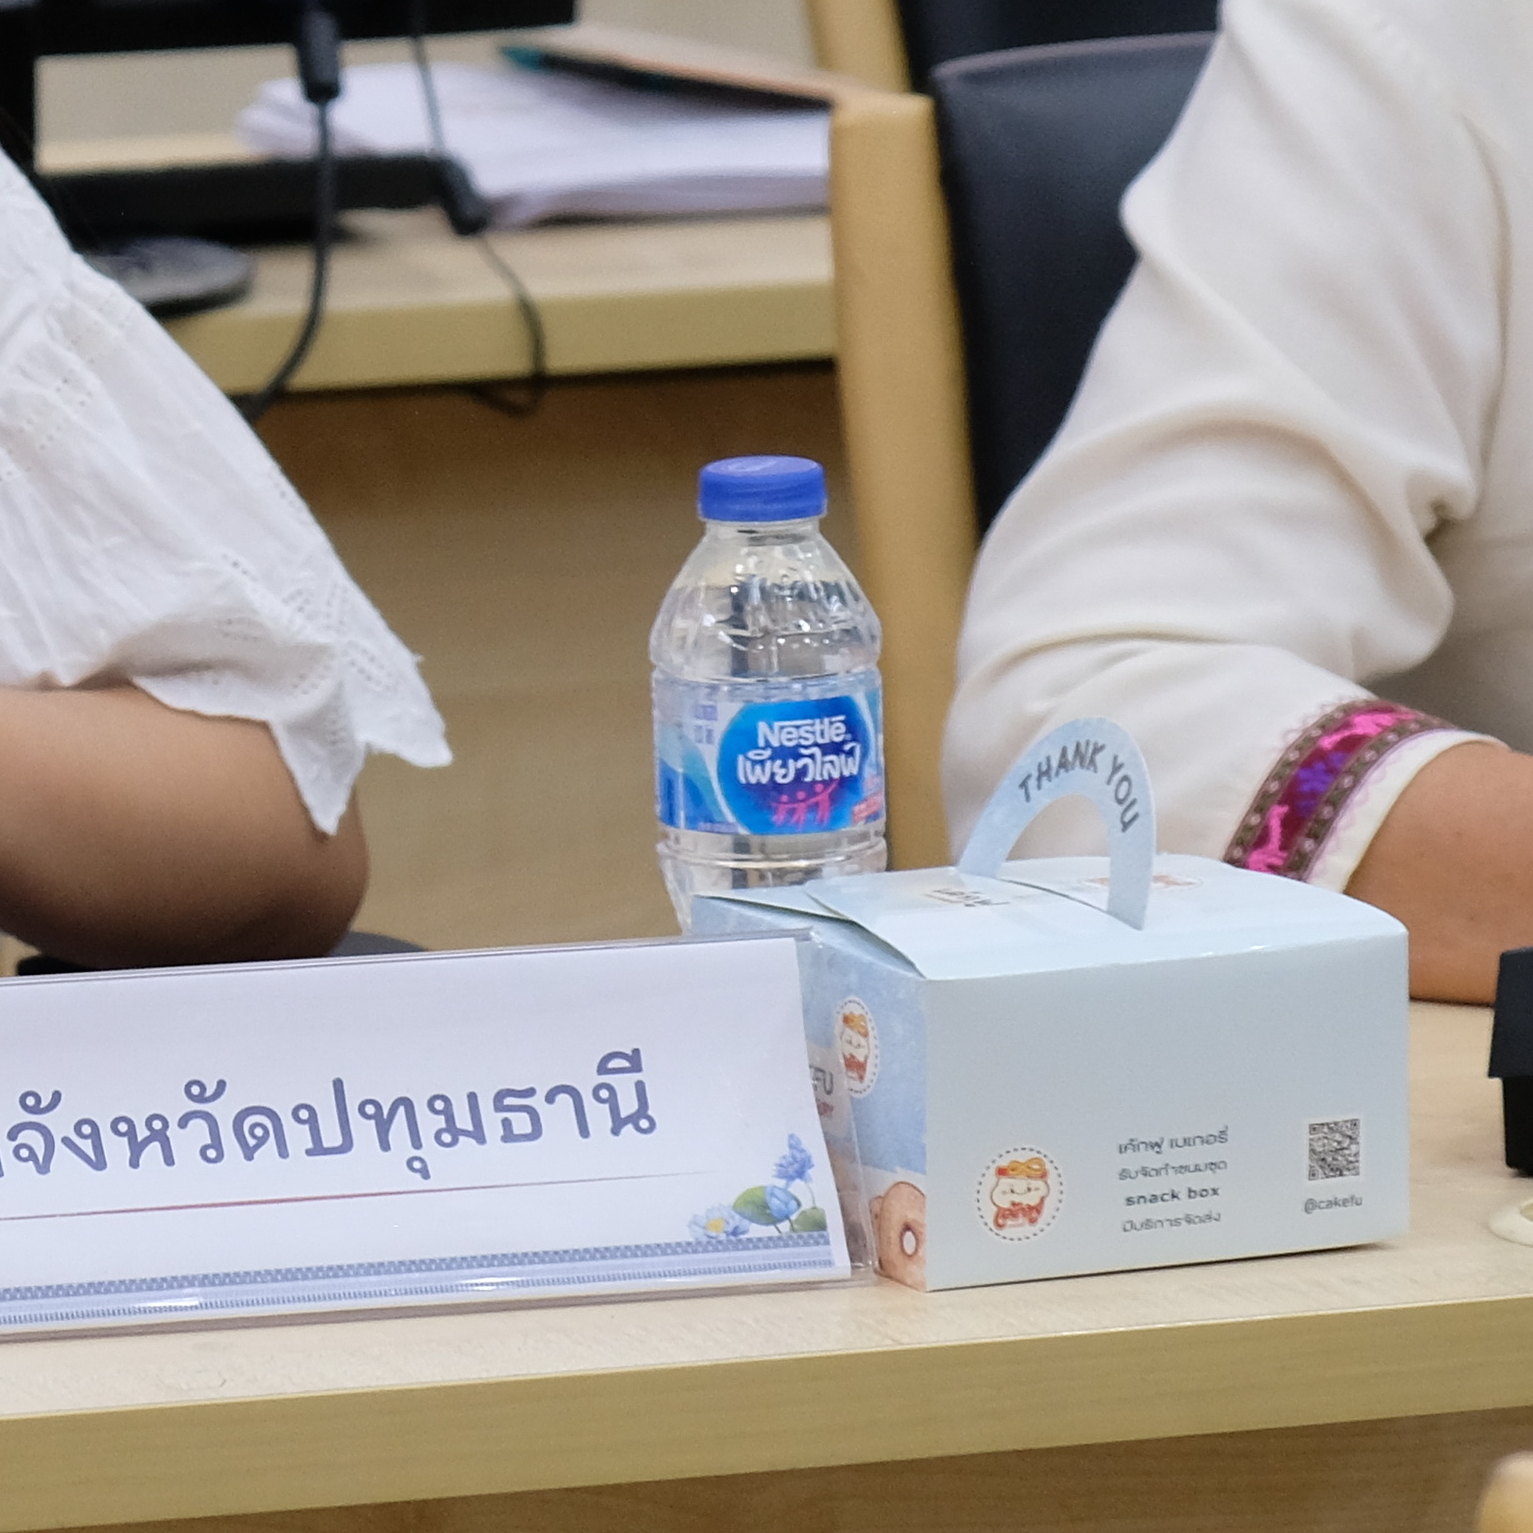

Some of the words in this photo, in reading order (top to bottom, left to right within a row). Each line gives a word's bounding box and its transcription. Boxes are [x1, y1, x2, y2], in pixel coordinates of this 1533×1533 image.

[1018, 738, 1107, 804] THANK
[1106, 753, 1140, 834] YOU
[1125, 1188, 1181, 1207] snack
[1187, 1186, 1220, 1200] box
[1304, 1194, 1363, 1215] @cakefu
